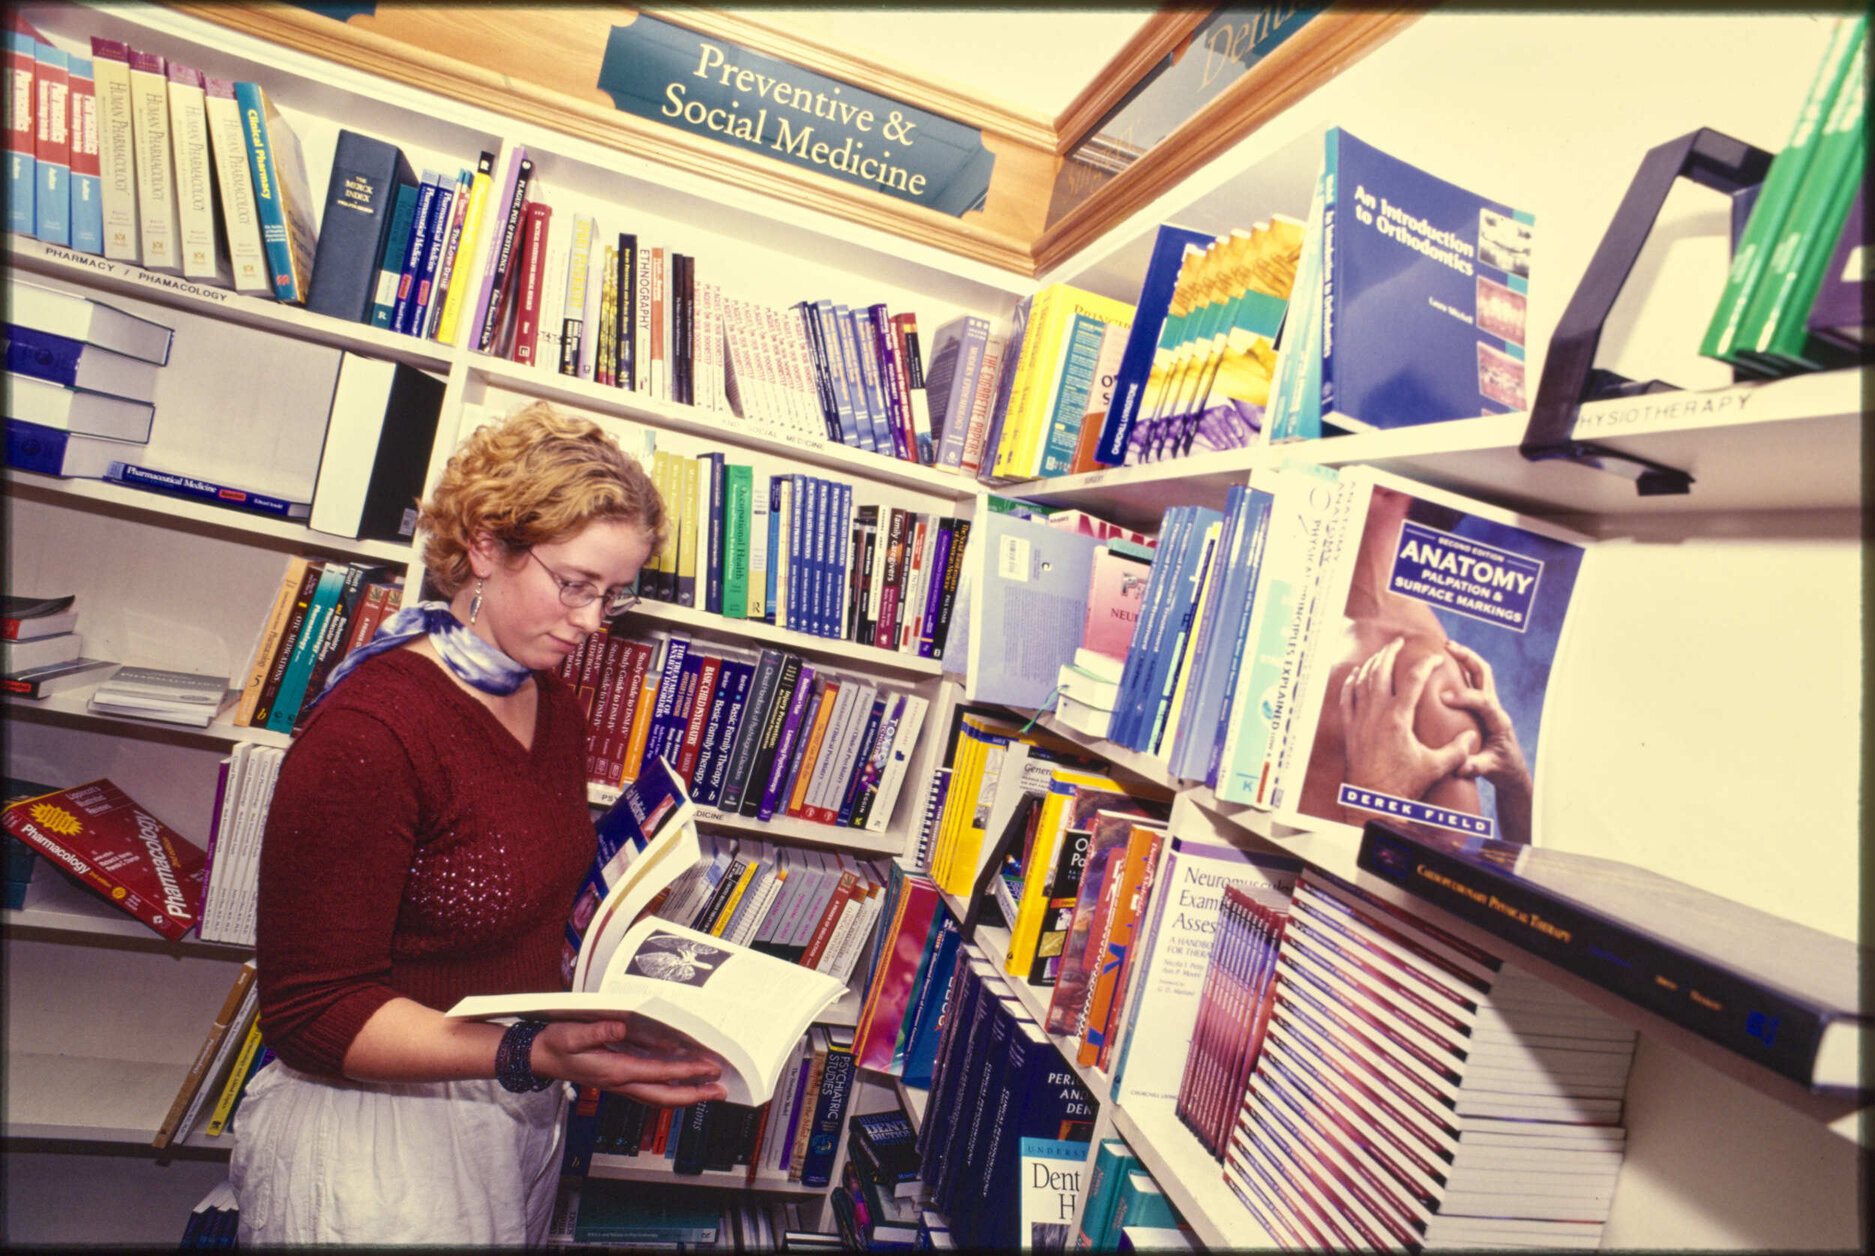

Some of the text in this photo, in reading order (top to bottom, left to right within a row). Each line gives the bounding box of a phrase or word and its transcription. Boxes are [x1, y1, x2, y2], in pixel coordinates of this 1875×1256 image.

[693, 43, 917, 146] Preventive &
[247, 108, 272, 200] Clinical Pharmacy
[661, 82, 927, 195] Social Medicine
[409, 186, 436, 269] Pharmaceutical Medicine
[1355, 185, 1474, 258] An Introduction
[1355, 204, 1474, 276] to Orthodontics
[45, 247, 115, 273] PHARMACY
[138, 271, 228, 302] PHAMACOLOGY
[425, 241, 441, 273] Medicine
[569, 219, 591, 309] SPORT PSYCHIATRY
[637, 247, 649, 330] ETHNOGRAPHY
[964, 353, 999, 456] THE CIGARETTE PAPERS
[1580, 392, 1751, 429] HYSIOTHERAPY
[125, 462, 218, 495] Pharmaceutical Medicine
[732, 484, 748, 581] Occupational Health
[884, 513, 904, 583] family caregivers
[956, 534, 968, 552] Social
[1438, 536, 1505, 562] SECOND EDITION
[1399, 540, 1535, 595] ANATOMY
[1421, 570, 1504, 603] PALPATION &
[1395, 576, 1523, 624] SURFACE MARKINGS
[273, 613, 303, 683] OTC MEDICATIONS
[298, 603, 322, 651] Pharmacology
[312, 607, 335, 654] Pharmacology
[326, 614, 341, 642] Molecular
[318, 640, 331, 662] Biology
[588, 640, 608, 671] DSM-IV
[605, 642, 620, 668] Study
[617, 644, 632, 670] Study
[633, 649, 648, 675] Study
[675, 643, 686, 662] THE
[599, 666, 614, 692] Guide
[612, 668, 627, 694] Guide
[628, 672, 643, 699] Guide
[653, 641, 680, 719] ANXIETY DISORDERS
[663, 660, 682, 706] TREATMENT
[778, 689, 792, 711] Injury
[1270, 659, 1293, 731] EXPLAINED
[685, 664, 715, 747] BASIC CHILD PSYCHIATRY
[709, 697, 724, 723] Basic
[727, 701, 742, 727] Basic
[700, 720, 719, 751] Family
[718, 724, 736, 755] Family
[877, 716, 900, 761] TOXIC
[692, 748, 712, 785] Therapy
[709, 752, 729, 789] Therapy
[767, 728, 794, 794] Learning Psychotherapy
[836, 752, 852, 785] Psychiatry
[1346, 790, 1487, 833] DEREK FIELD
[20, 822, 91, 876] Pharmacology
[133, 809, 191, 919] Pharmacology
[808, 939, 820, 958] ACTION
[822, 1053, 840, 1096] STUDIES
[827, 1055, 851, 1120] PSYCHIATRIC
